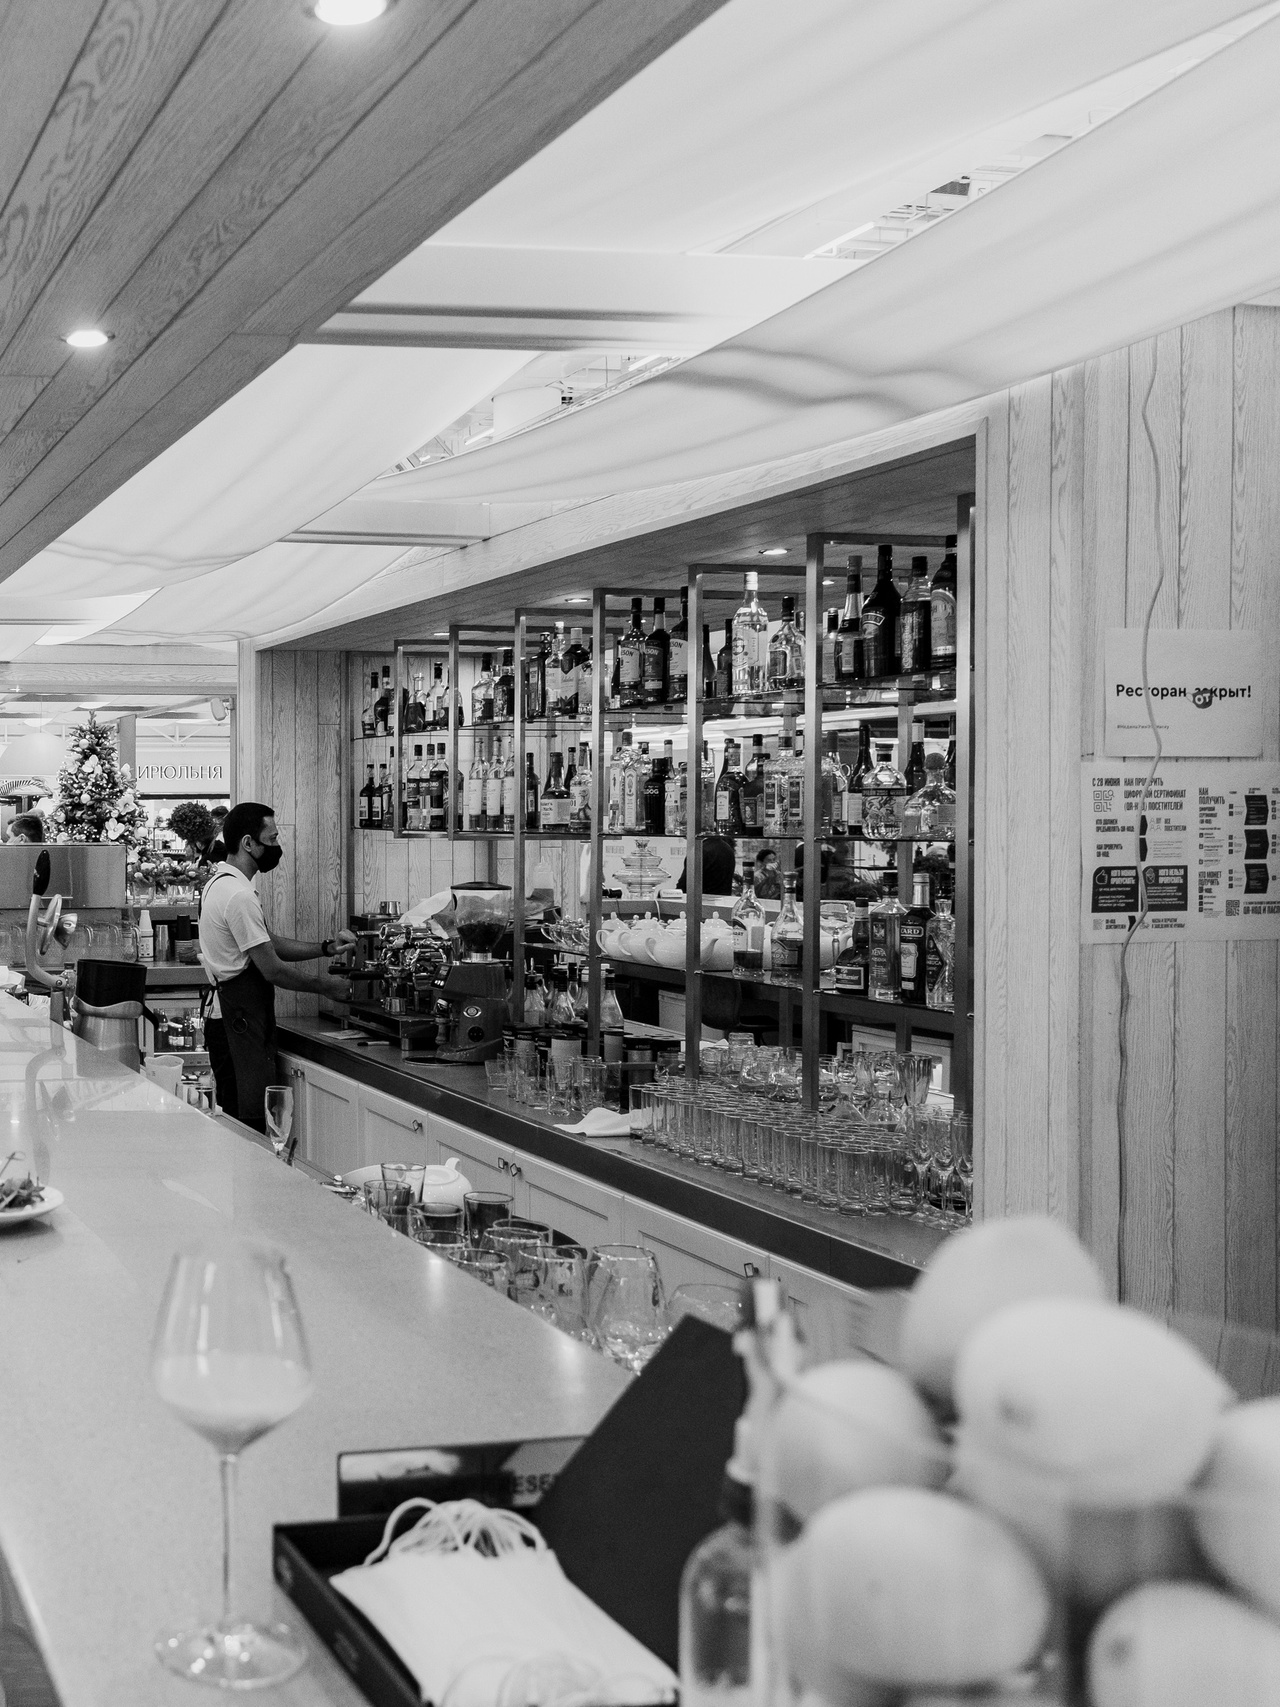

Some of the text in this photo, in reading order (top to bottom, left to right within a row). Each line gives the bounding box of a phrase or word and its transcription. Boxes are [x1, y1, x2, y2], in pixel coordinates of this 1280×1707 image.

[1116, 684, 1252, 701] Ресоран крыт!
[137, 765, 223, 780] ИРЮЛЬНЯ
[1134, 777, 1163, 786] ПРОЕРИТЬ
[1124, 787, 1186, 798] ЦИФРООЙ СЕРТИФИКАТ
[1199, 787, 1209, 796] КАК
[1199, 795, 1225, 805] ПОЛУЧИТЬ
[1124, 800, 1184, 812] (QR-КД) ПОСЕТИТЕЛЕЙ
